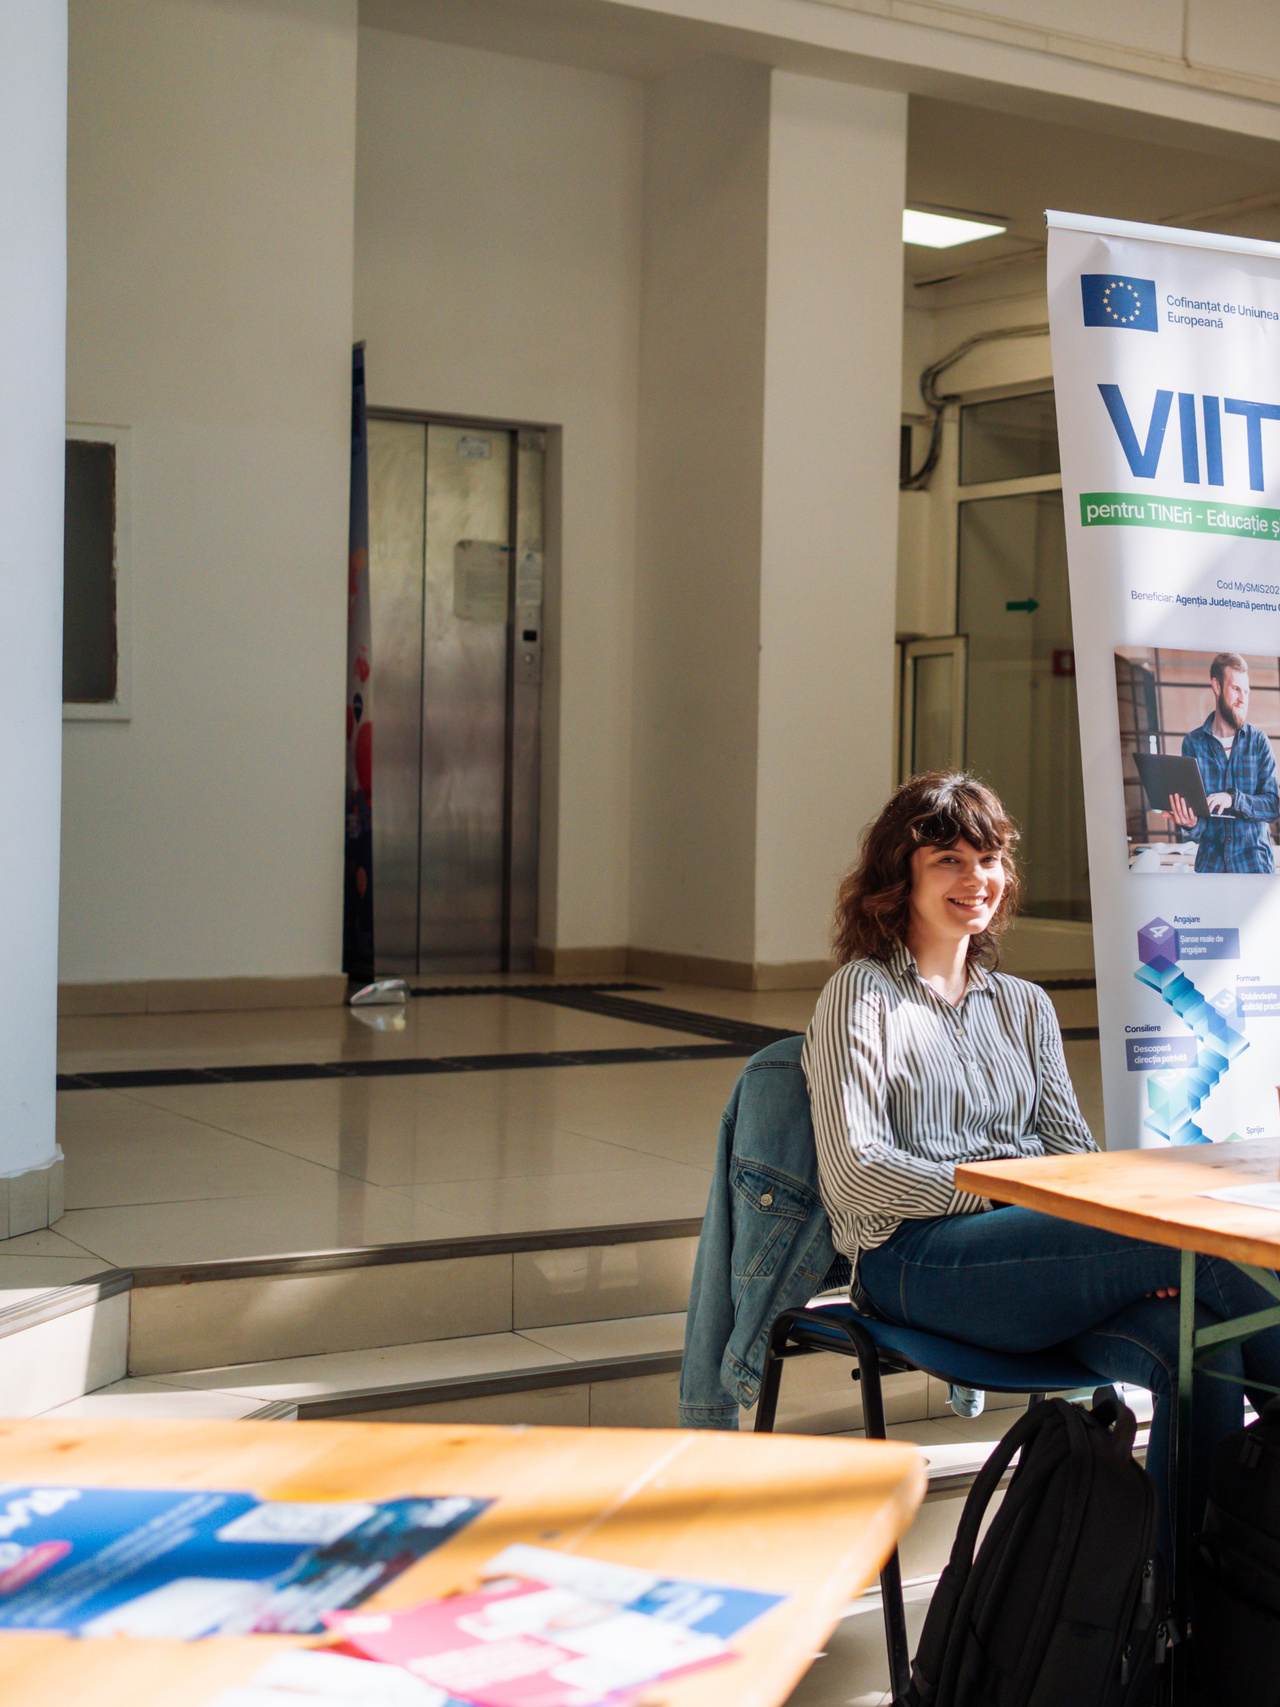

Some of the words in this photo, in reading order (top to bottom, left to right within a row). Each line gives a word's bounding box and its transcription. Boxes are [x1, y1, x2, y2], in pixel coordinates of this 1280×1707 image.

[1166, 295, 1221, 314] Cofinanțat
[1223, 303, 1236, 314] de
[1237, 304, 1279, 320] Uniunea
[1167, 311, 1224, 328] Europeană
[1087, 502, 1145, 523] pentru
[1147, 503, 1193, 525] TINEri
[1207, 509, 1269, 536] Educație
[1216, 579, 1233, 591] Cod
[1131, 590, 1174, 603] Beneficiar:
[1175, 594, 1208, 608] Agenția
[1208, 597, 1250, 610] Județeană
[1251, 601, 1277, 612] pentru
[1173, 915, 1200, 925] Angajare
[1149, 925, 1169, 939] 4
[1200, 935, 1215, 943] reale
[1215, 935, 1224, 943] de
[1181, 945, 1207, 955] angajare
[1236, 974, 1261, 982] Formare
[1124, 1024, 1161, 1033] Consiliere
[1133, 1044, 1172, 1054] Descoperă
[1246, 1126, 1265, 1135] Sprijin
